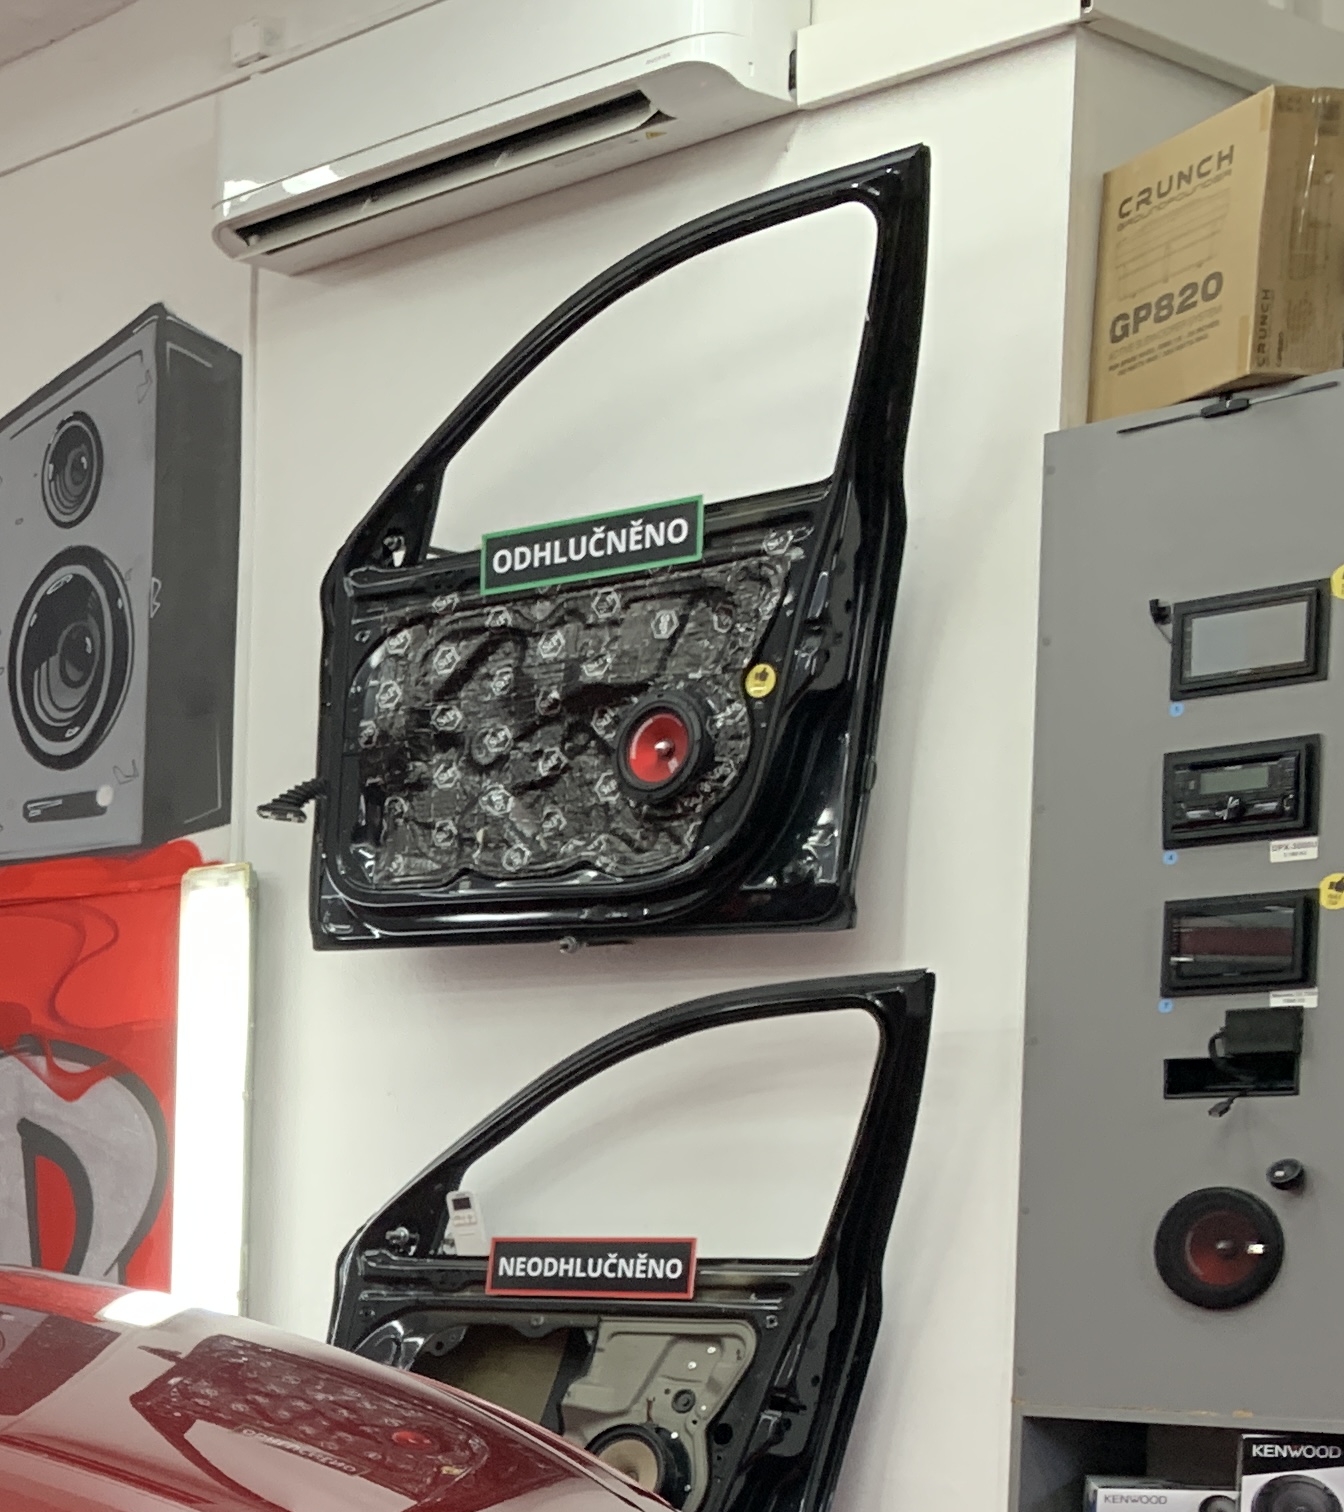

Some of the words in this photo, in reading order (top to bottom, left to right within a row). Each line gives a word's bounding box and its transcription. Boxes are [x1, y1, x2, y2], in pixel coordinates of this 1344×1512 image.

[1118, 144, 1235, 219] CRUNCH
[1109, 271, 1224, 344] GP820
[1257, 289, 1271, 368] CRUNCH
[492, 517, 689, 574] ODHLUČNĚNO
[498, 1252, 683, 1279] NEODHLUČNĚNO
[1252, 1444, 1342, 1459] KENWOOD
[1103, 1494, 1168, 1505] KENWOOD
